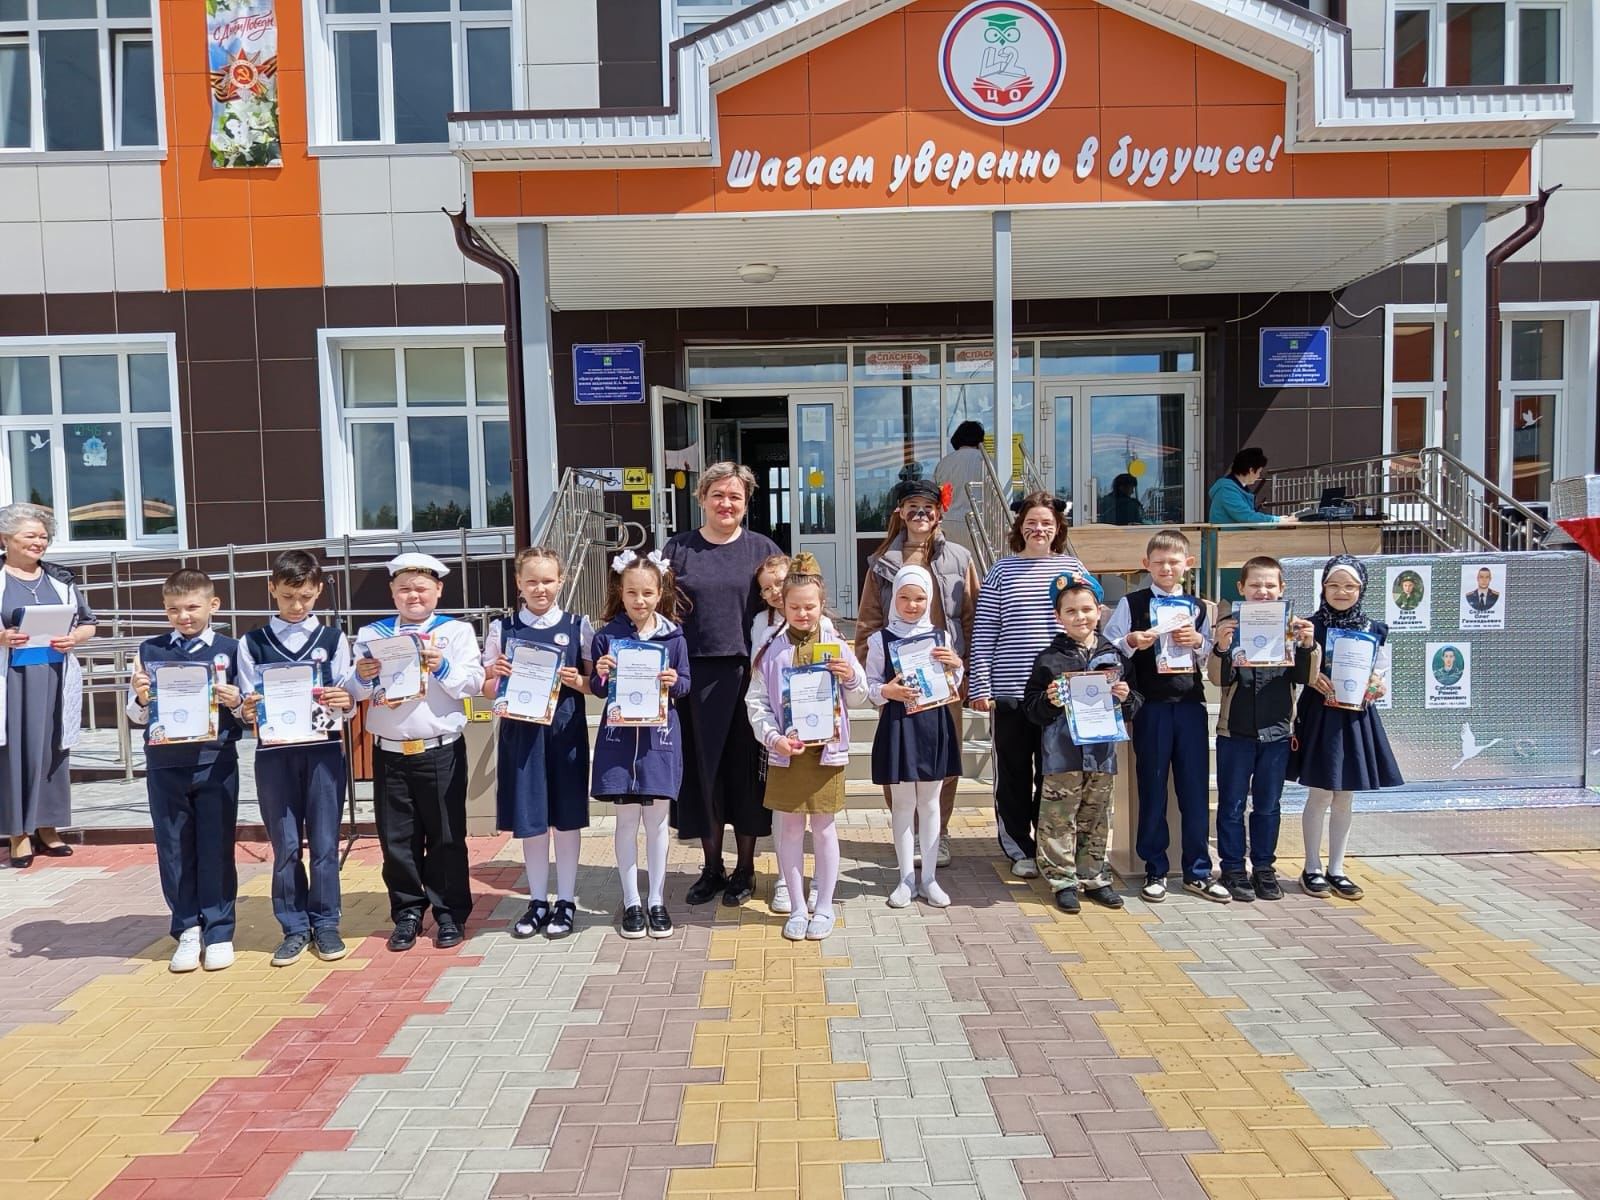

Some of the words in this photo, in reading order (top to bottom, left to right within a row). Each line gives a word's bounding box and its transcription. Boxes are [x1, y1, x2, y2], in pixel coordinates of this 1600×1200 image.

[726, 150, 874, 188] Шагаем
[888, 140, 1061, 193] уверенно
[1076, 136, 1099, 179] в
[1108, 134, 1283, 188] будущее!
[876, 352, 919, 361] СПАСИБО
[965, 350, 994, 359] СПАС
